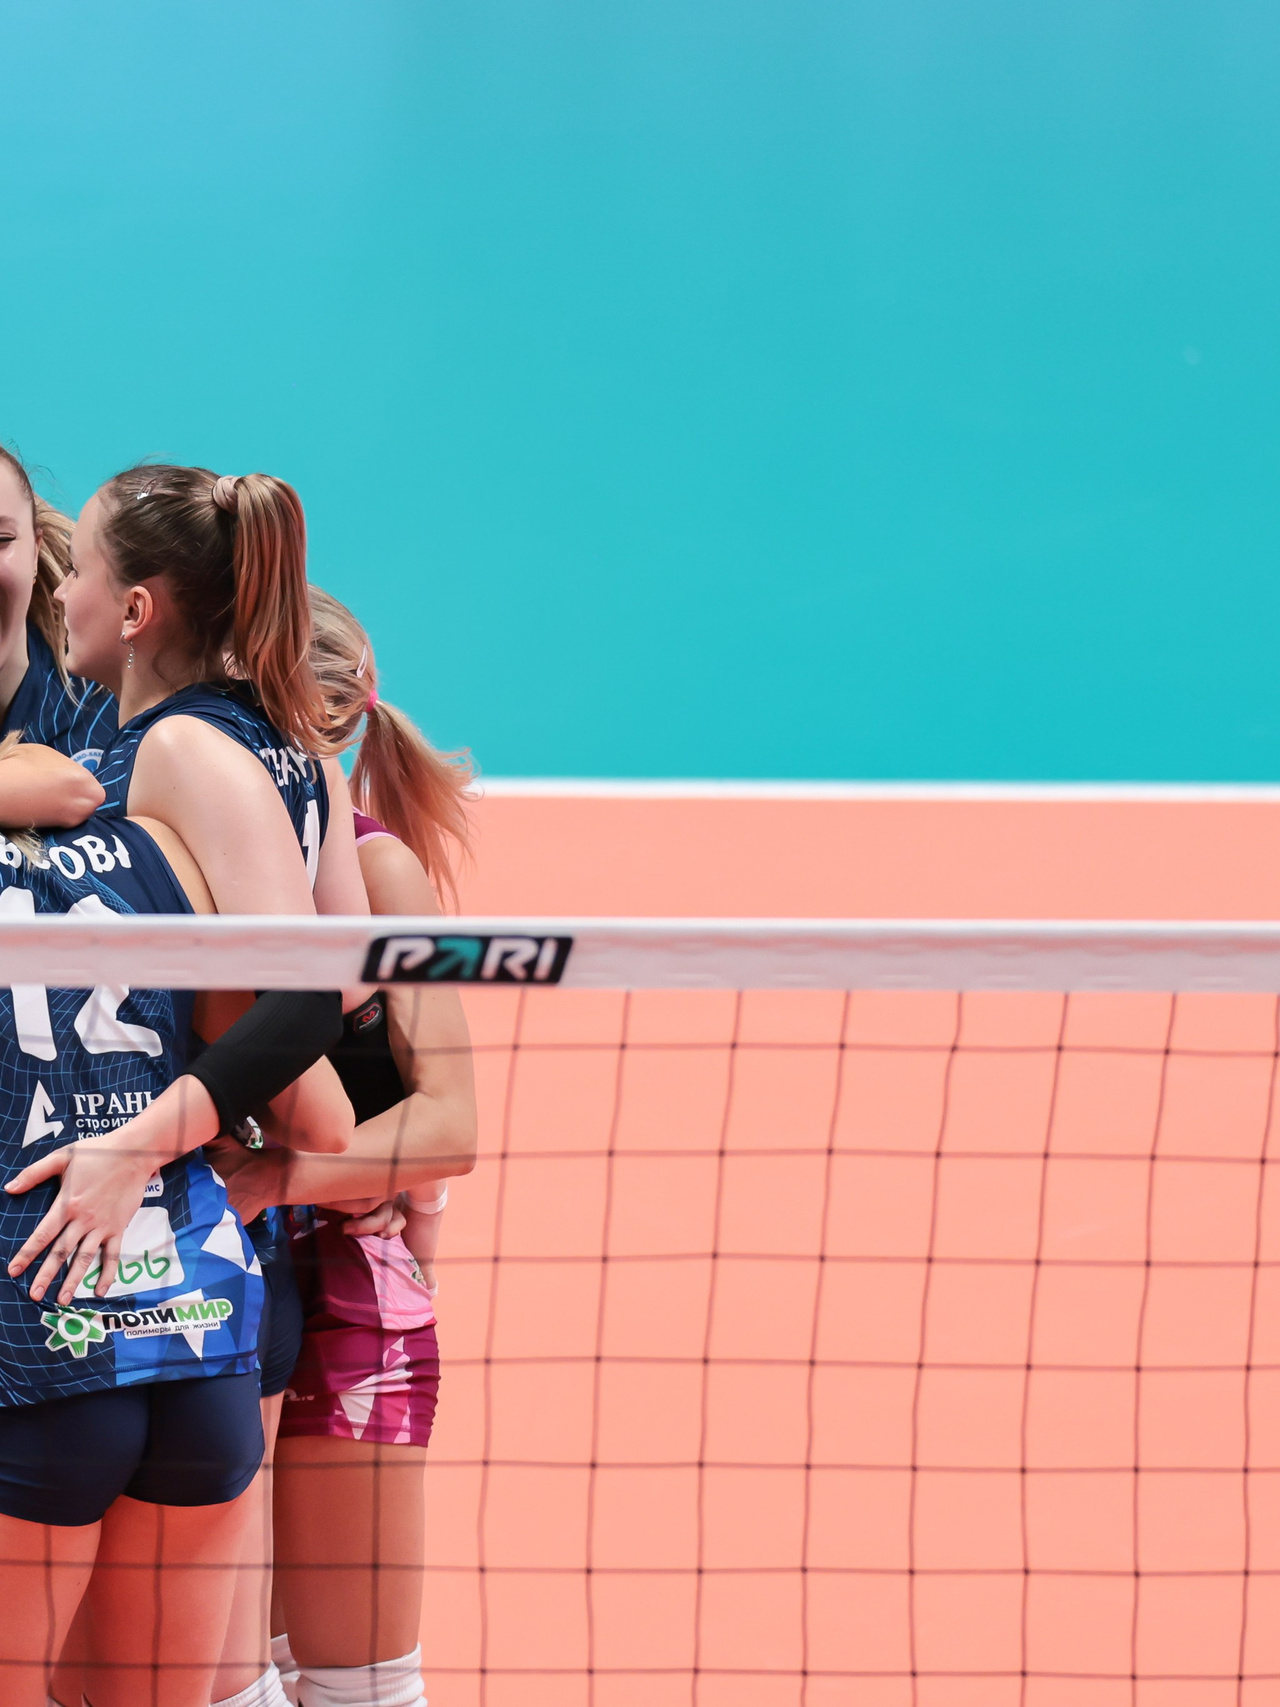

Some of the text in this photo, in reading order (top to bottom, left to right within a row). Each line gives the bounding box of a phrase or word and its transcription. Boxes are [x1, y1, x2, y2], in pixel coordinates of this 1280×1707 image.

[375, 936, 559, 981] PARI
[102, 1301, 231, 1331] ПОЛИМИР
[126, 1322, 219, 1337] полимеры для жизни
